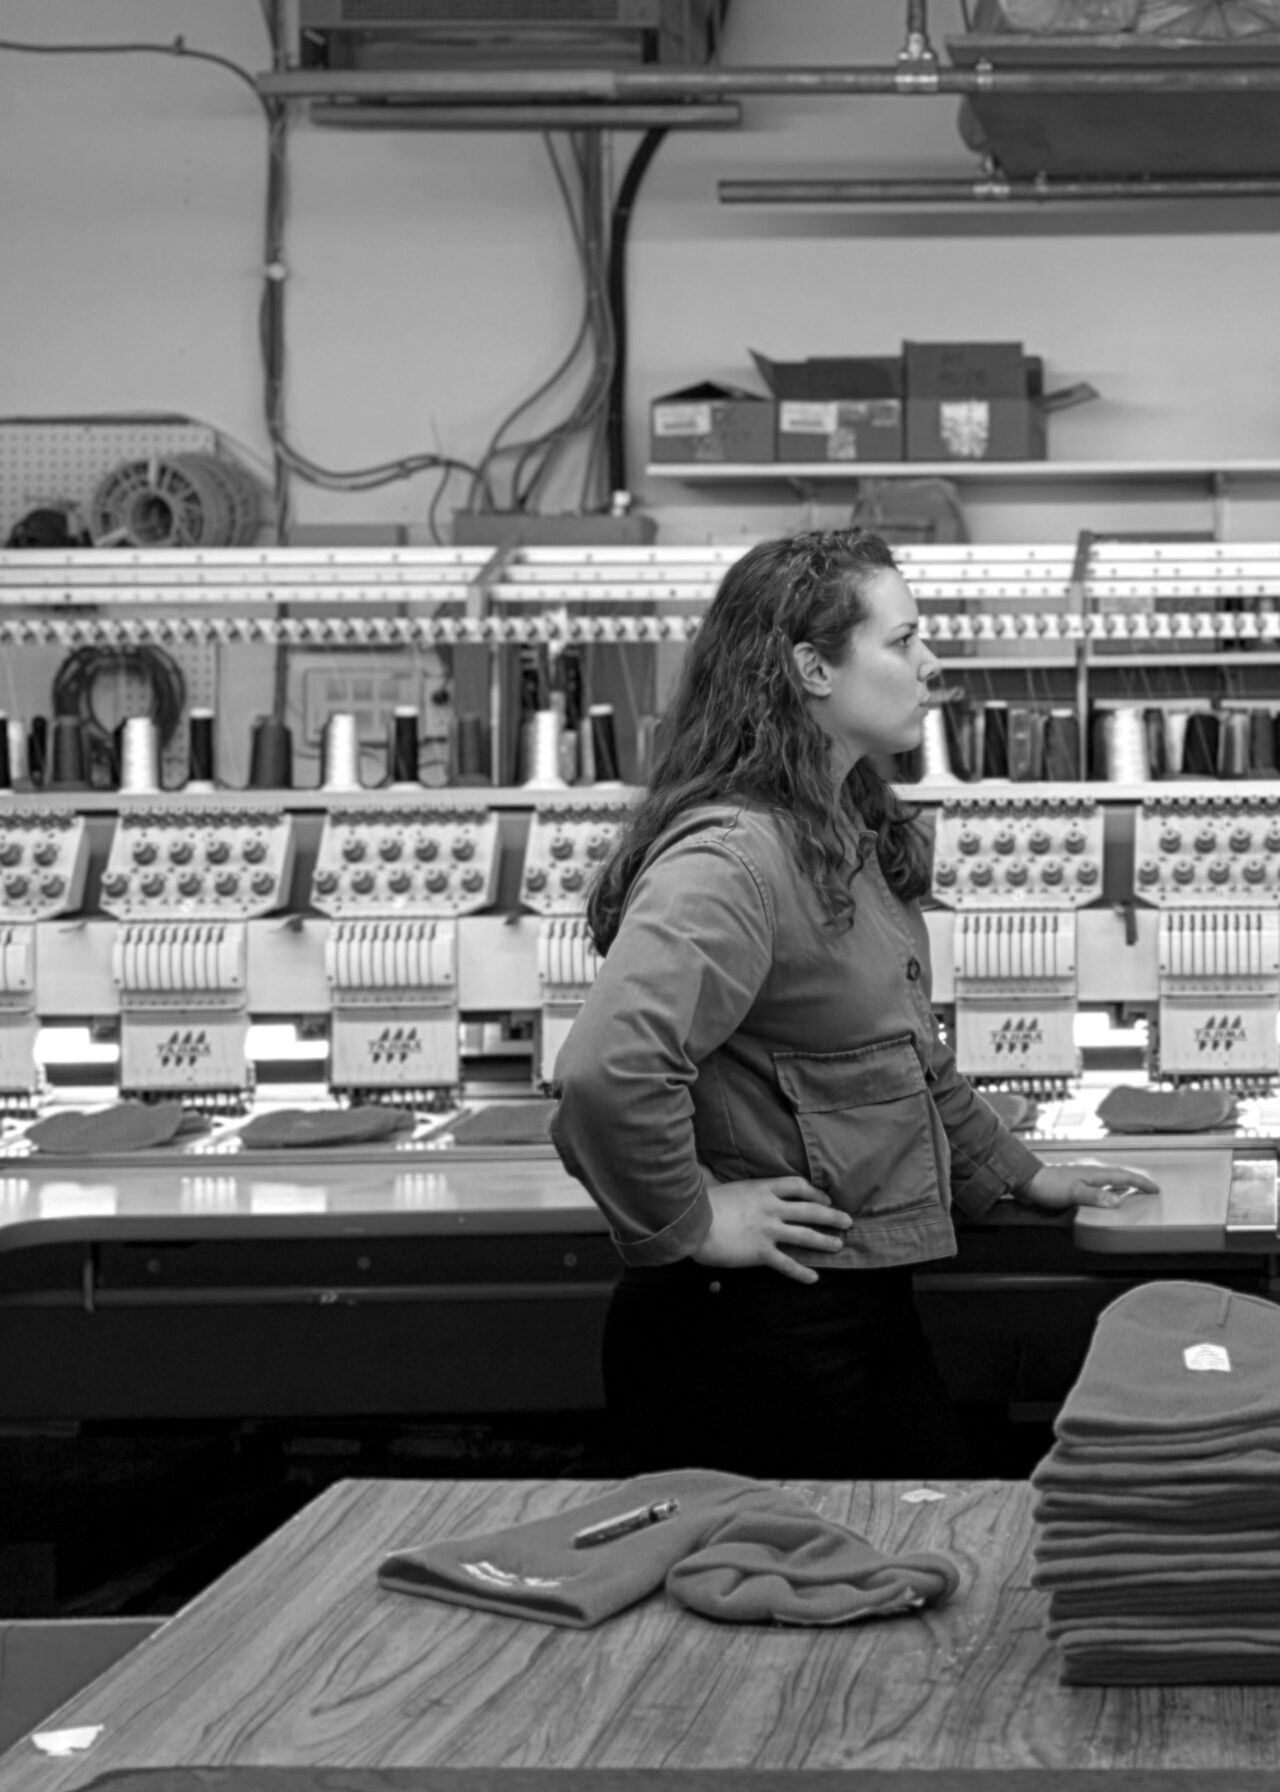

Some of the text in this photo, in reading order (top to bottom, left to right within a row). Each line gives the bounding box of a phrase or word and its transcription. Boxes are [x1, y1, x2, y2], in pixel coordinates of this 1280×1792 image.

[991, 1032, 1042, 1043] TAJIMA
[1194, 1029, 1245, 1040] TAJIMA
[158, 1044, 211, 1055] TAJIMA
[369, 1042, 421, 1053] TAJIMA
